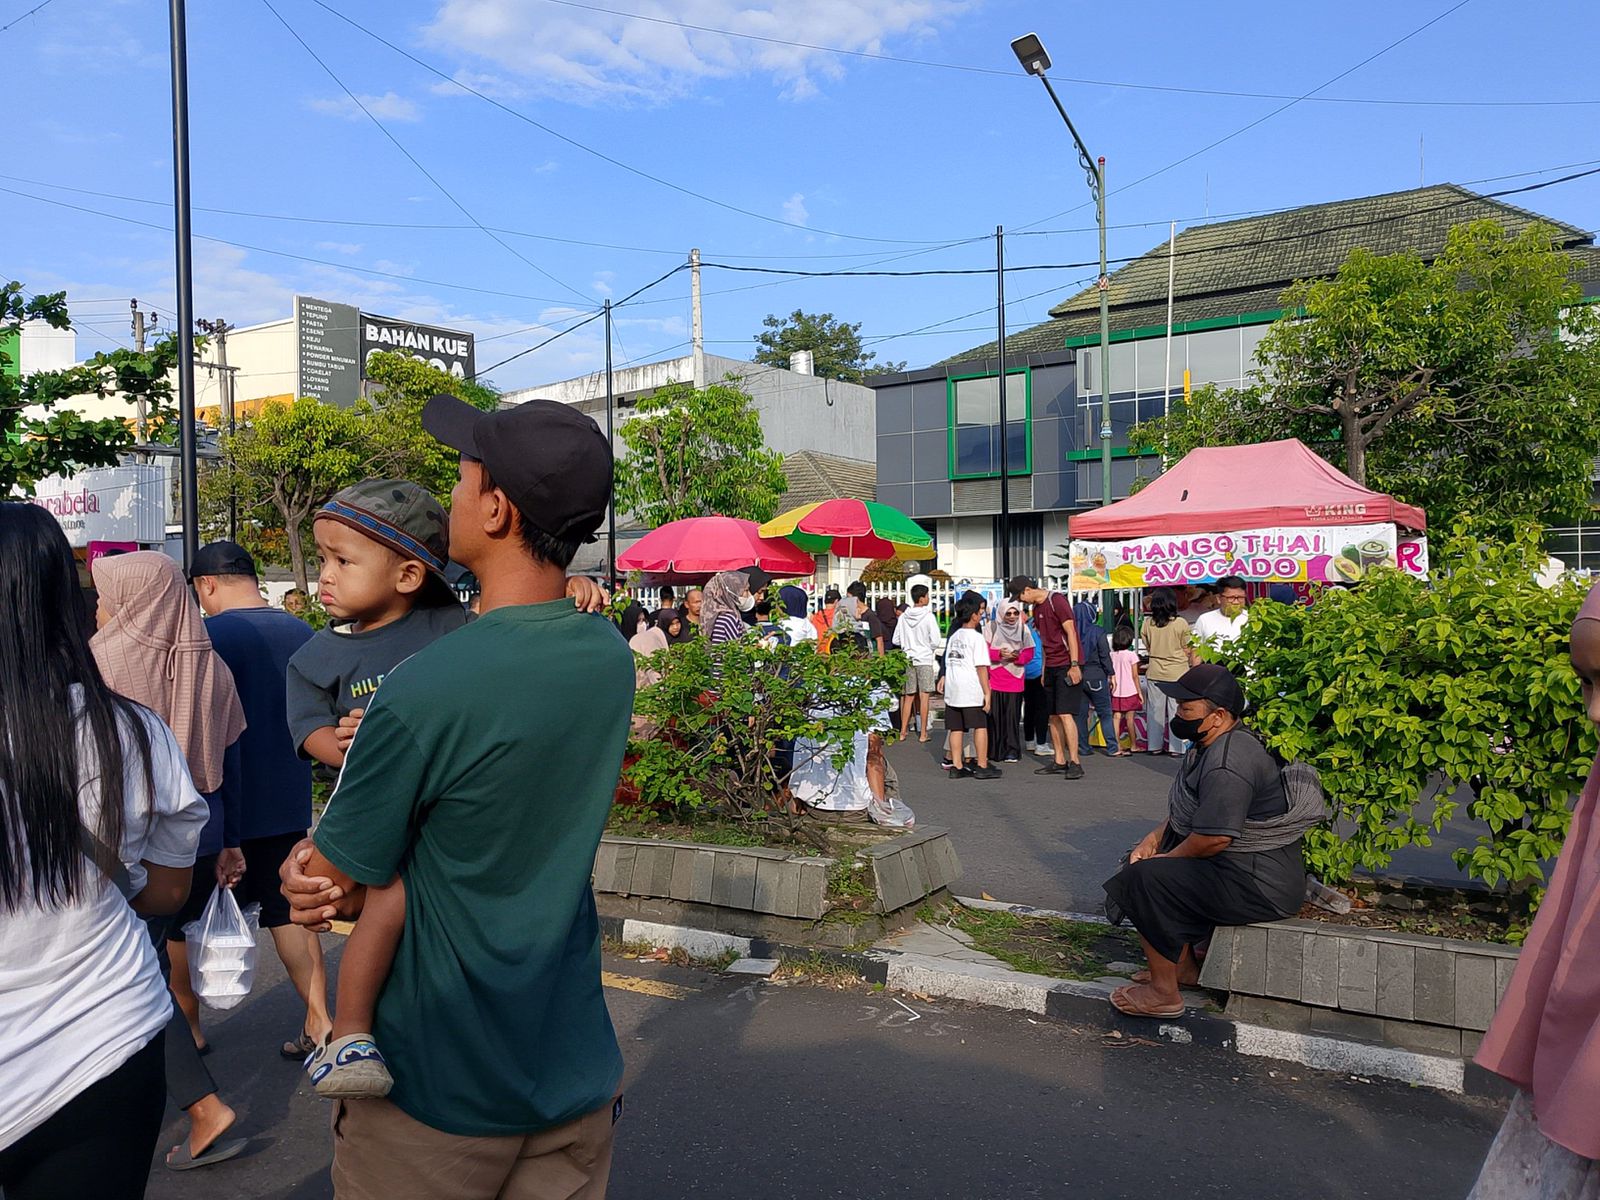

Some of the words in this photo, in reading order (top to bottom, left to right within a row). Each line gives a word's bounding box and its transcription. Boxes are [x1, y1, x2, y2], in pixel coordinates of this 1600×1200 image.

[305, 304, 332, 313] MENTEGA
[305, 319, 323, 328] PASTA
[306, 335, 321, 343] KEJU
[365, 323, 430, 351] BAHAN
[432, 335, 468, 357] KUE
[306, 383, 329, 392] PLASTIK
[1324, 503, 1367, 517] KING
[1122, 535, 1236, 563] MANGO
[1242, 533, 1322, 554] THAI
[1144, 556, 1300, 583] AVOCADO
